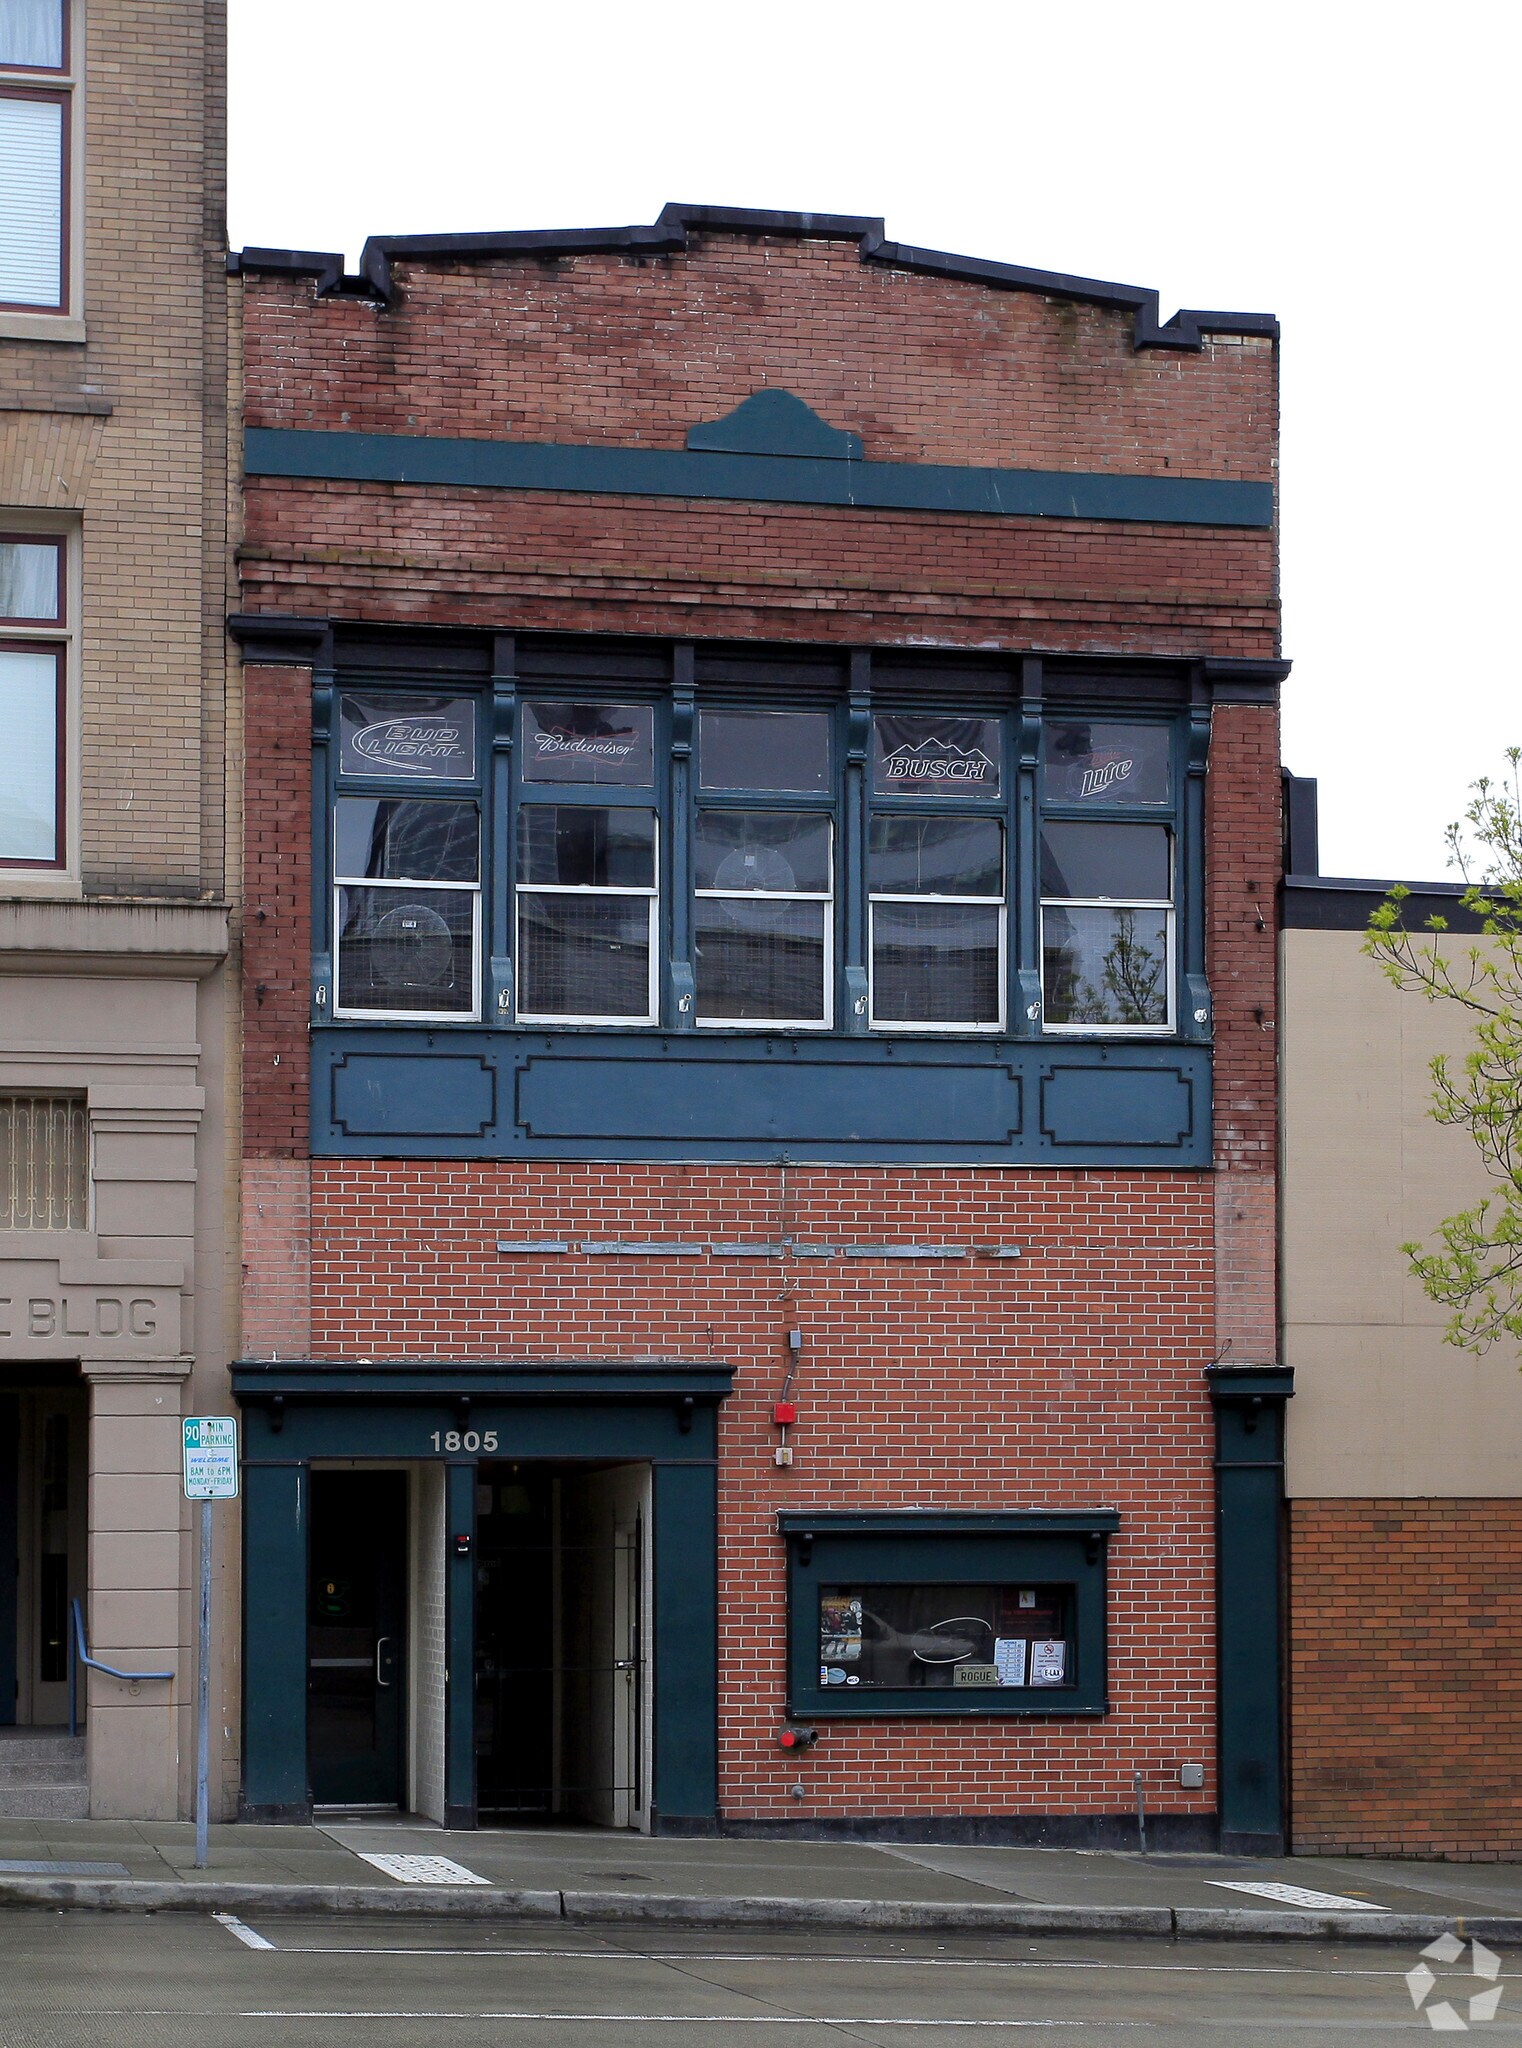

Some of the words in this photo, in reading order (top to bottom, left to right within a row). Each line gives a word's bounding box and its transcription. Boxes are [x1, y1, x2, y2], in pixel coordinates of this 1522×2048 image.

[386, 725, 459, 741] BUD
[364, 739, 460, 757] LIGHT
[534, 733, 634, 756] Budweiser
[888, 757, 986, 780] BUSCH
[1080, 759, 1133, 797] Lite
[28, 1298, 157, 1339] BLDG
[185, 1425, 199, 1441] 90
[210, 1423, 223, 1432] MIN
[201, 1434, 233, 1445] PARKING
[430, 1431, 498, 1452] 1805
[190, 1466, 204, 1476] 8AM
[207, 1467, 215, 1476] to
[217, 1466, 231, 1476] 6PM
[961, 1671, 992, 1682] ROGUE
